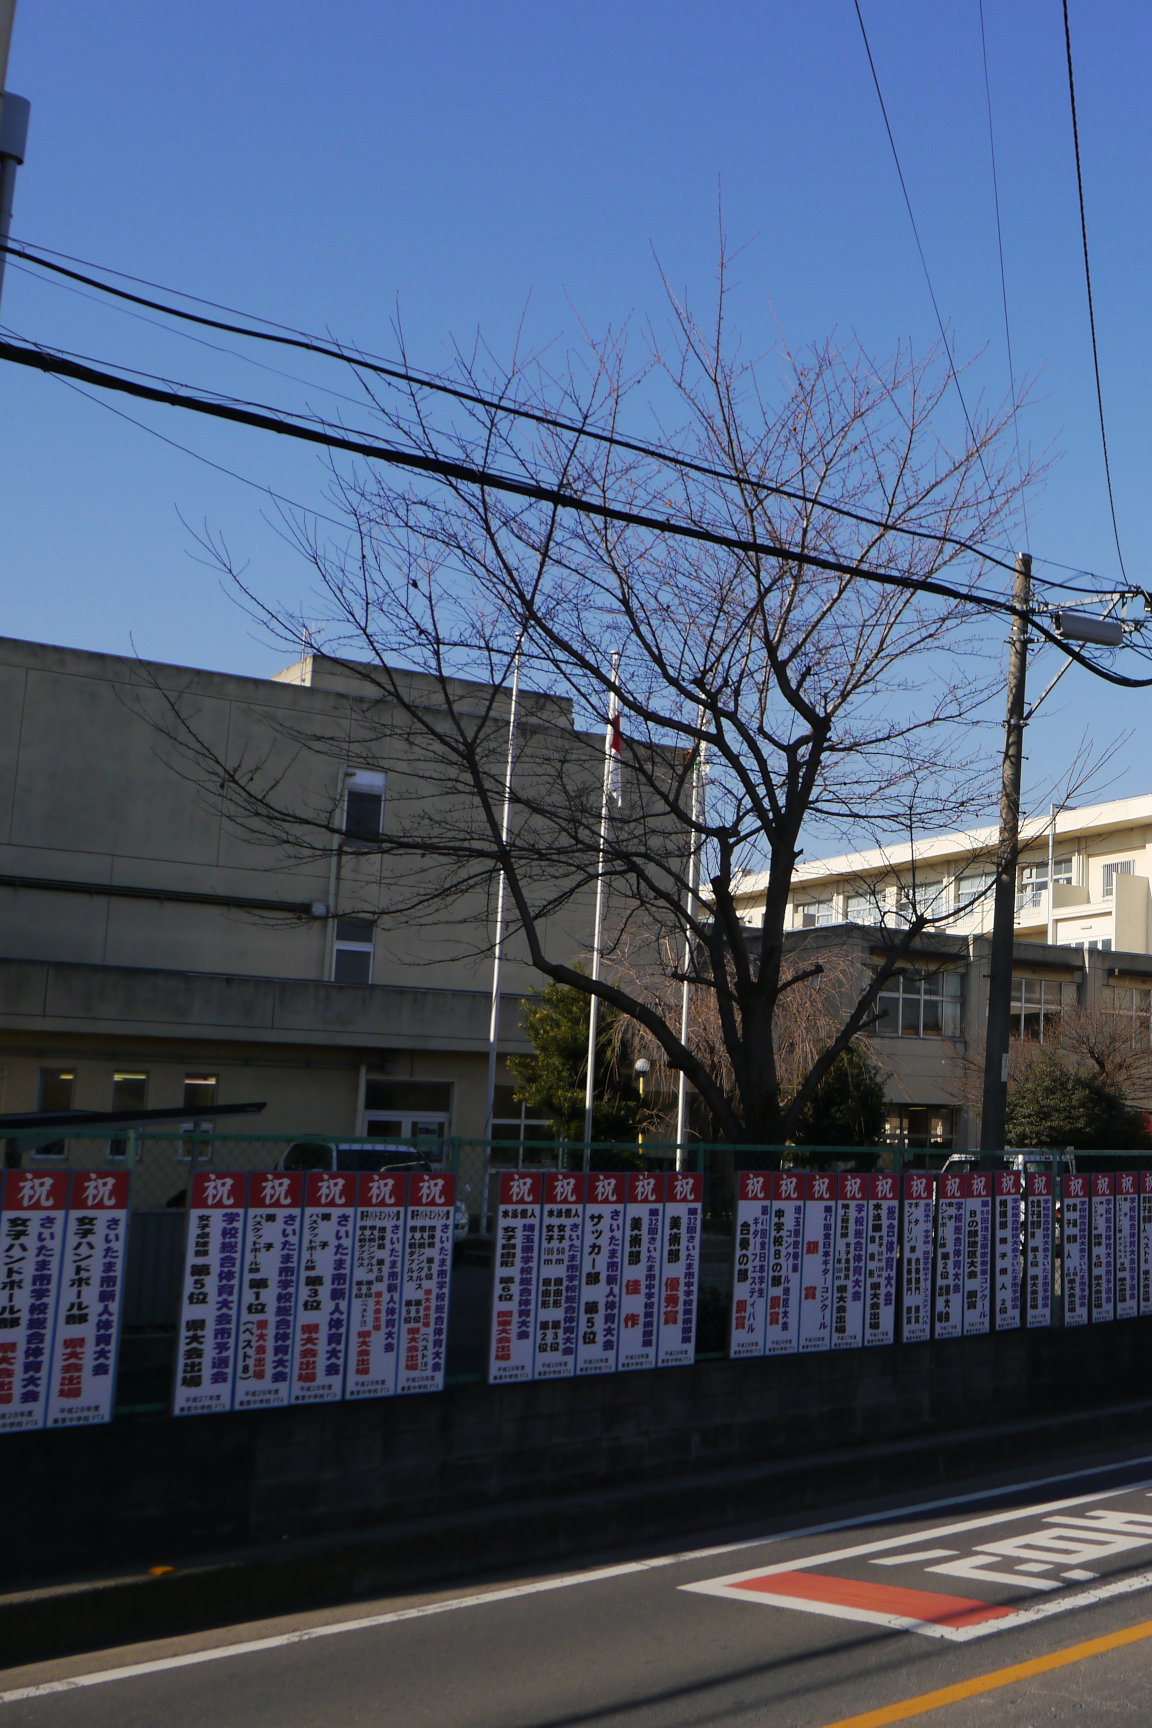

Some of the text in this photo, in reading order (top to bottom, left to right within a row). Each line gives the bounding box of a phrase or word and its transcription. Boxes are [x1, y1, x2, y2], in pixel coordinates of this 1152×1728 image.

[17, 1173, 54, 1207] 祝
[82, 1173, 116, 1206] 祝
[202, 1174, 235, 1206] 祝
[260, 1174, 292, 1205] 祝
[317, 1174, 349, 1204] 祝
[368, 1174, 398, 1204] 祝
[418, 1175, 446, 1204] 祝
[509, 1175, 533, 1202] 祝
[553, 1175, 576, 1202] 祝
[595, 1175, 617, 1201] 祝
[635, 1175, 656, 1201] 祝
[674, 1175, 694, 1200] 祝
[746, 1174, 764, 1198] 祝
[779, 1174, 797, 1198] 祝
[812, 1175, 829, 1198] 祝
[845, 1175, 862, 1198] 祝
[876, 1176, 893, 1198] 祝
[911, 1176, 927, 1198] 祝
[945, 1176, 960, 1197] 祝
[972, 1175, 986, 1196] 祝
[1001, 1173, 1015, 1194] 祝
[1034, 1174, 1047, 1194] 祝
[1069, 1176, 1083, 1196] 祝
[1097, 1175, 1109, 1194] 祝
[1121, 1174, 1133, 1193] 祝
[547, 1209, 580, 1218] 水泳個人
[737, 1221, 751, 1282] 合奏の部
[757, 1205, 768, 1298] 第41回全日本学生
[771, 1208, 784, 1288] 中学校Bの部
[792, 1205, 802, 1273] 埼玉県吹奏楽
[852, 1203, 865, 1302] 学校総合体育大会
[884, 1206, 896, 1306] 総合体育大会
[939, 1202, 950, 1280] ハンドボール部 第2位
[952, 1201, 963, 1294] 学校総合体育大会
[967, 1210, 978, 1280] Bの部地区大会
[979, 1200, 990, 1319] 第56回埼玉県吹奏楽コンクール
[0, 1217, 31, 1329] 女子ハンドボール部
[247, 1214, 269, 1314] バスケットボール部 第1位
[375, 1259, 385, 1282] 第5位
[517, 1223, 535, 1340] 埼玉県学校総合体育大会
[583, 1214, 604, 1345] サッカー部 第5位
[603, 1209, 621, 1351] さいたま市新人体育大会
[624, 1217, 642, 1328] 美術部 佳作
[664, 1216, 681, 1325] 美術部 優秀賞
[747, 1217, 760, 1334] ギターフェスティバル
[781, 1230, 792, 1332] コンクール地区大会
[819, 1205, 833, 1330] 第47回全日本ギターコンクール
[20, 1216, 56, 1404] さいたま市学校総合体育大会
[57, 1216, 98, 1398] 女子ハンドボール部 県大会出場
[92, 1217, 121, 1376] さいたま市新人体育大会
[181, 1214, 212, 1387] 女子卓球部 第5位 県大会出場
[210, 1212, 240, 1384] 学校総合体育大会市予選会
[272, 1214, 298, 1383] さいたま市学校総合体育大会
[297, 1213, 324, 1383] バスケットボール部 第3位 県大会出場
[325, 1213, 350, 1376] さいたま市新人体育大会
[372, 1291, 383, 1331] 県大会出場
[384, 1224, 400, 1353] さいたま市新人体育大会
[422, 1289, 432, 1328] 県大会出場
[432, 1224, 450, 1372] さいたま市学校総合体育大会
[498, 1276, 514, 1302] 第6位
[562, 1223, 580, 1356] さいたま市学校総合体育大会
[835, 1285, 847, 1334] 県大会出場
[869, 1282, 881, 1330] 県大会出場
[1030, 1275, 1038, 1309] 県大会出場
[253, 1319, 268, 1380] 県大会出場
[355, 1330, 372, 1375] 県大会出場
[405, 1327, 420, 1371] 県大会出場
[538, 1321, 549, 1353] 第2位
[550, 1320, 561, 1352] 第3位
